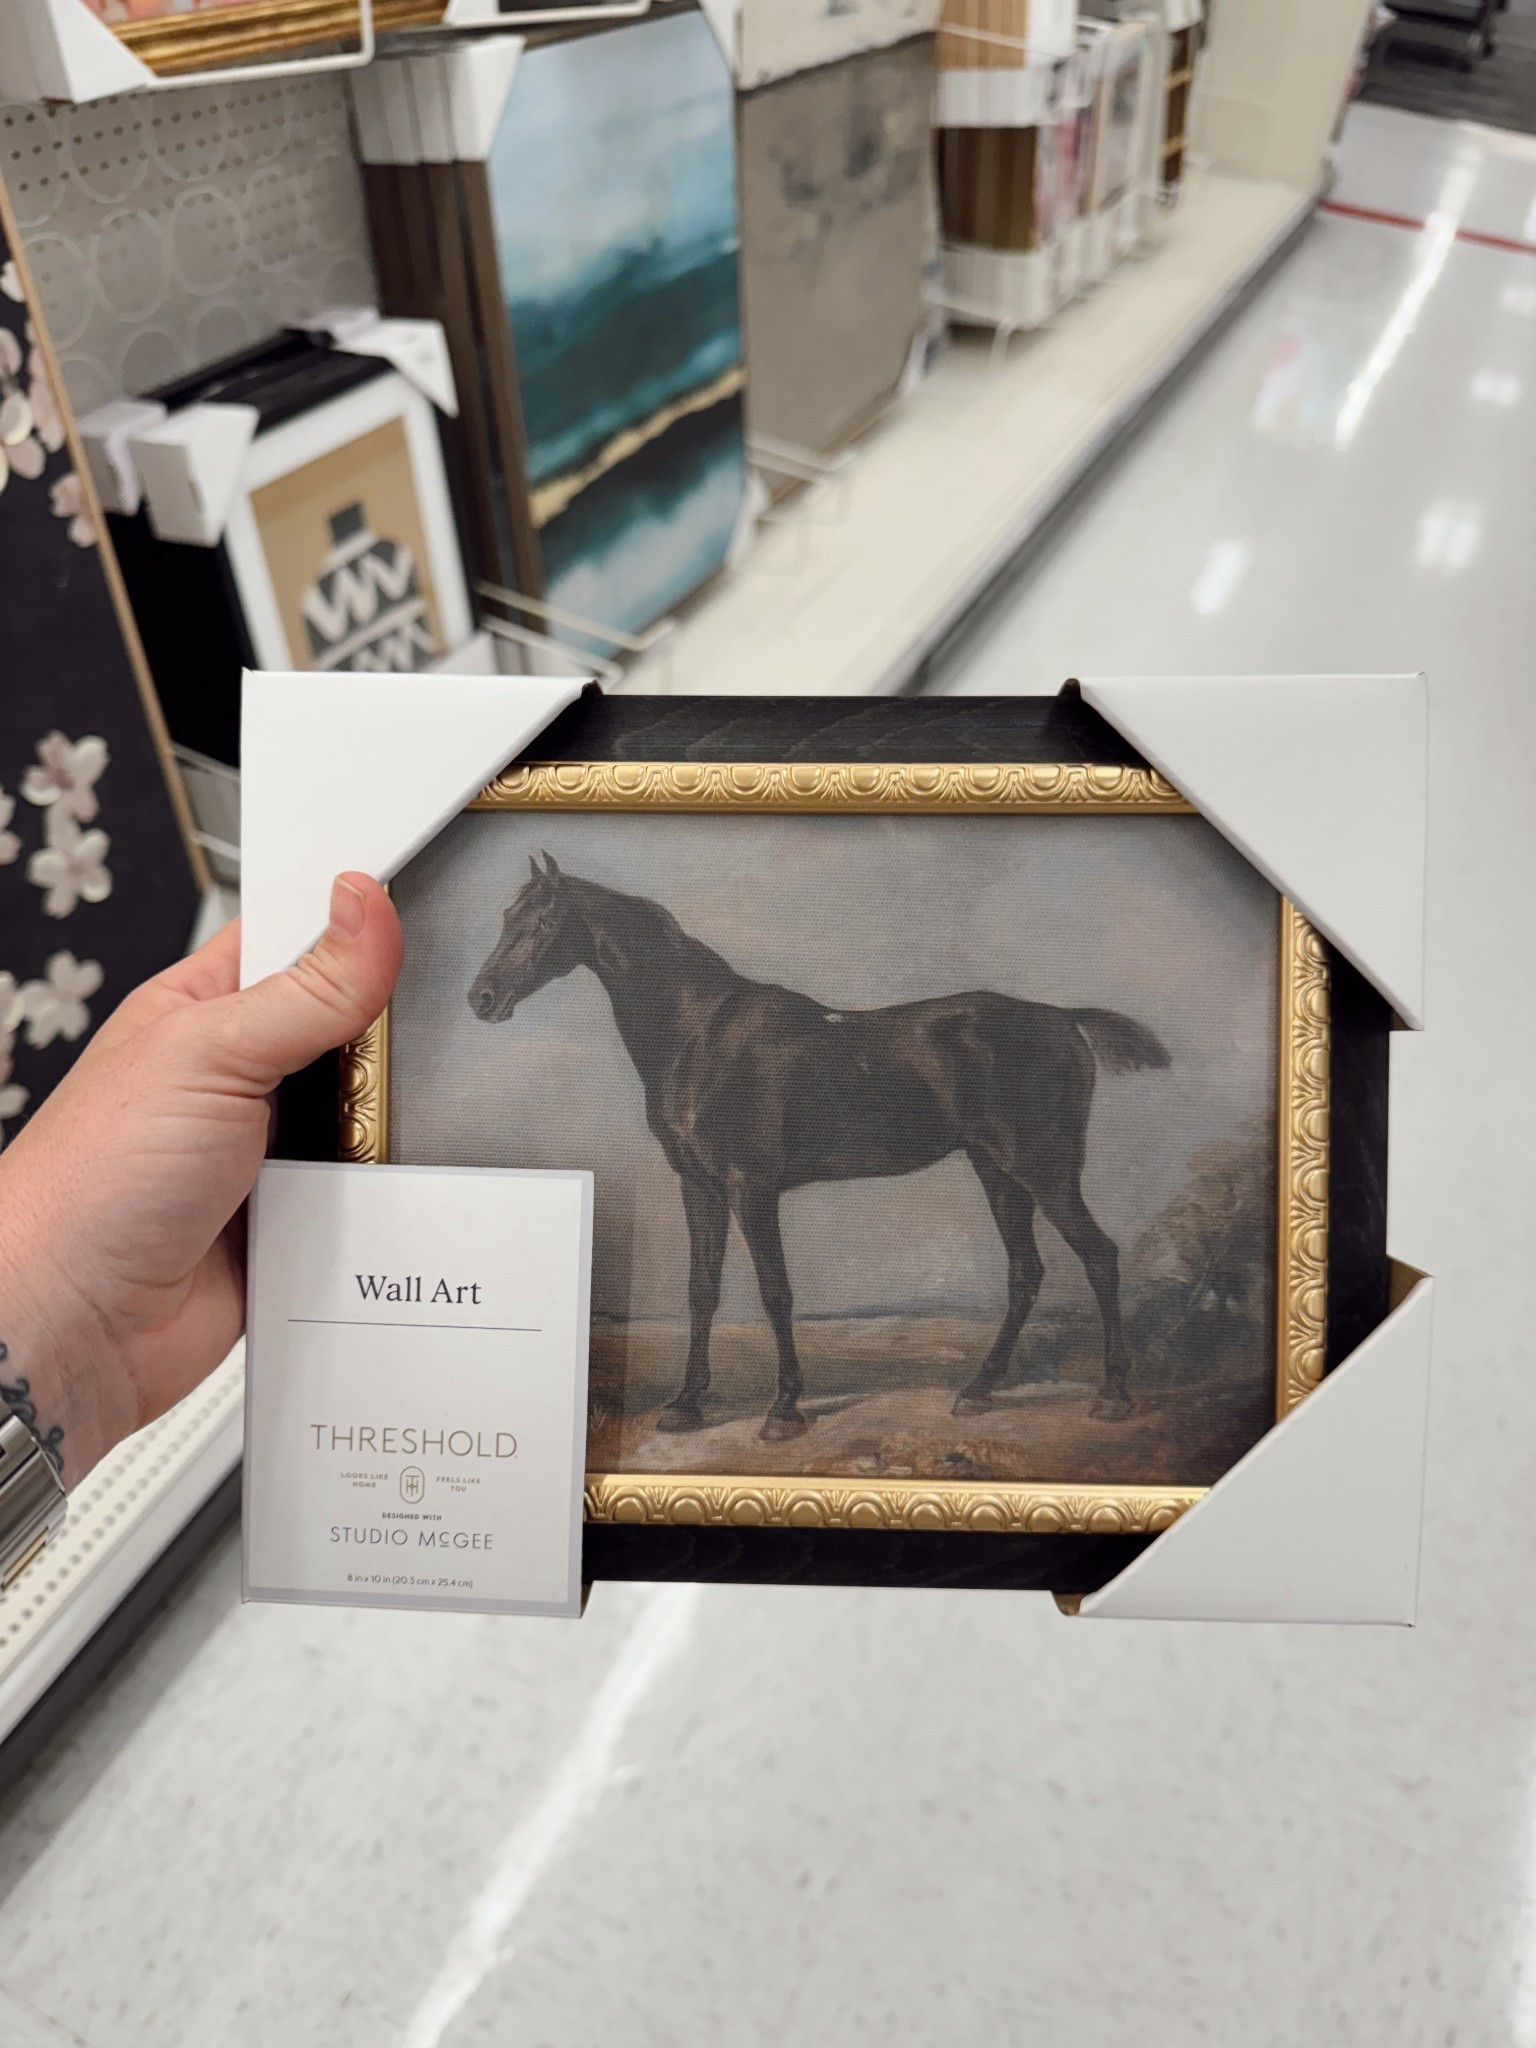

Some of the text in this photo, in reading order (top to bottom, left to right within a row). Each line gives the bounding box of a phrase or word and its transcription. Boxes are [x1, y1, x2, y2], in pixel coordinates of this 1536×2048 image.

[355, 1275, 482, 1305] Wall Art
[311, 1424, 518, 1458] THRESHOLD
[340, 1472, 368, 1480] LOOKS
[382, 1512, 442, 1521] DESIGNED WITH
[330, 1526, 408, 1546] STUDIO
[347, 1574, 353, 1582] 8
[355, 1574, 363, 1582] in
[371, 1574, 381, 1583] 10
[382, 1575, 391, 1583] in
[392, 1576, 415, 1585] (20.3
[437, 1578, 456, 1587] 25.4
[457, 1579, 473, 1589] cm)
